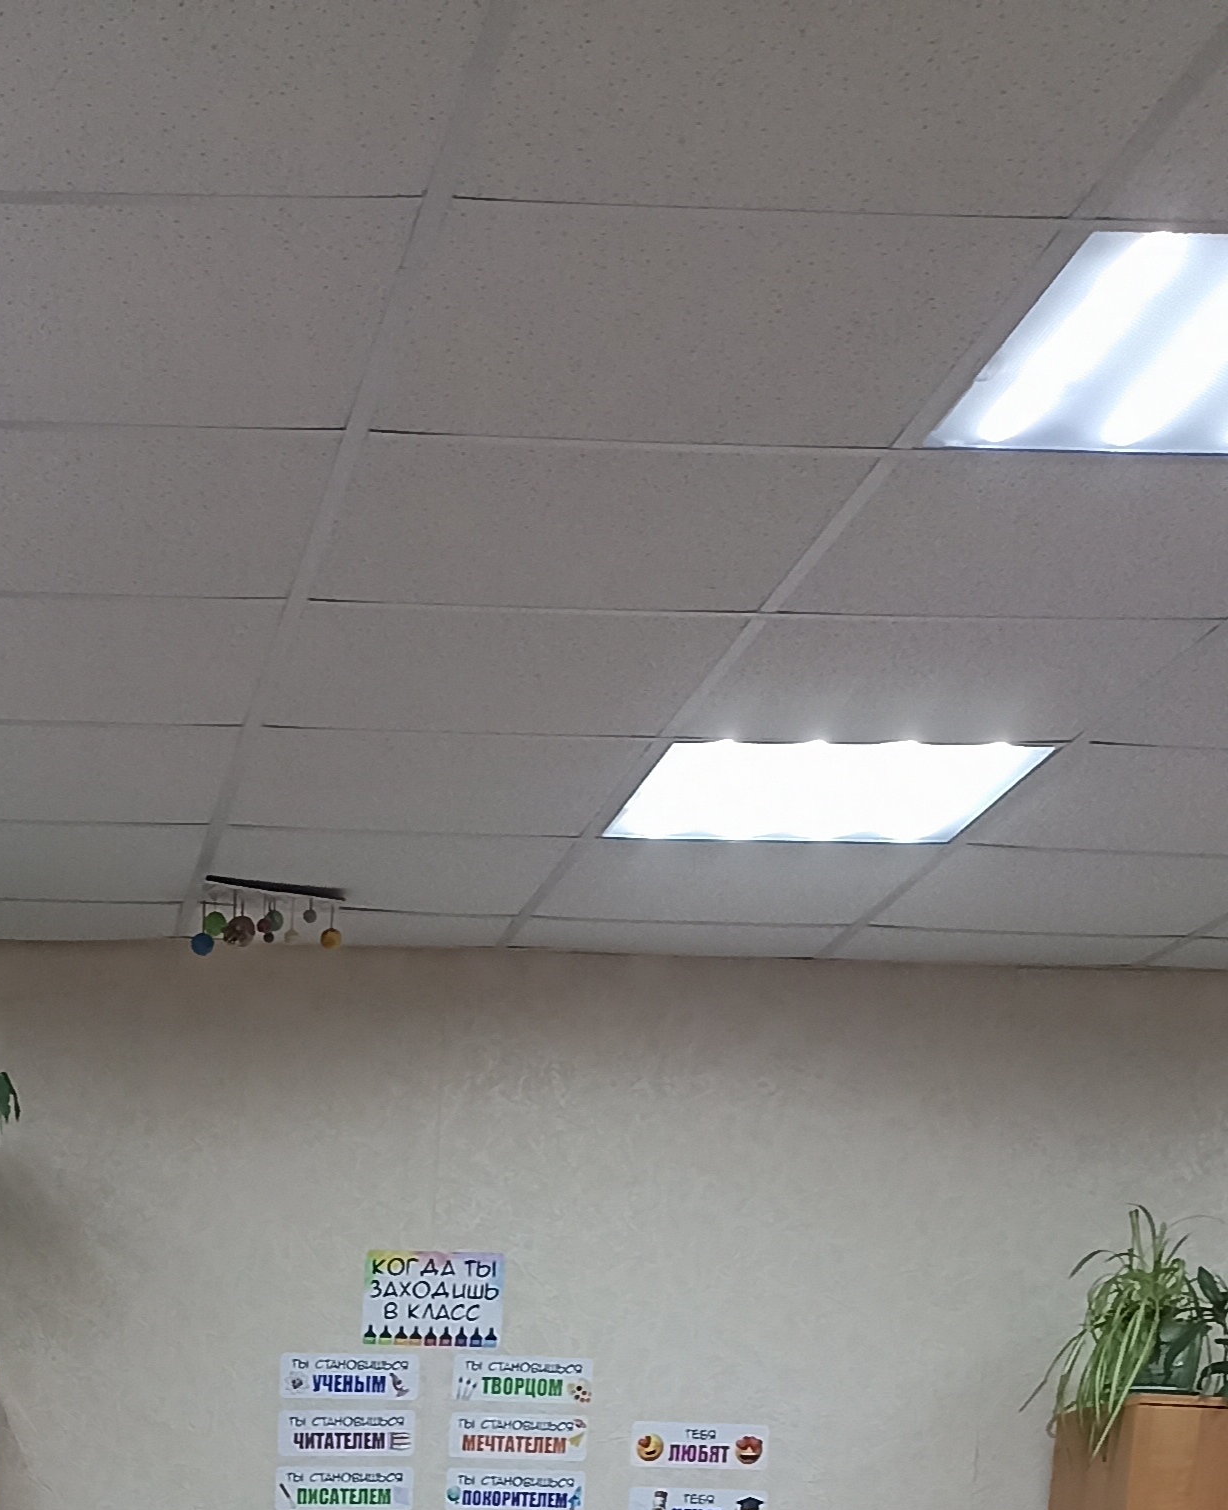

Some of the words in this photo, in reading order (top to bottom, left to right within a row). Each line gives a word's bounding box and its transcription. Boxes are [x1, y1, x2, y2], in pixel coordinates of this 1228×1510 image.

[372, 1257, 456, 1277] КОГДА
[464, 1259, 497, 1278] ТЫ
[370, 1279, 500, 1301] ЗАХОДИШЬ
[384, 1302, 398, 1320] В
[407, 1303, 481, 1321] КЛАСС
[292, 1358, 309, 1370] ТЫ
[314, 1358, 409, 1371] СТАНОВИШЬСЯ
[465, 1360, 483, 1371] ТЫ
[488, 1361, 583, 1374] СТАНОВИШЬСЯ
[312, 1374, 386, 1393] УЧЕНЫМ
[481, 1376, 563, 1398] ТВОРЦОМ
[289, 1416, 306, 1427] ТЫ
[311, 1416, 405, 1427] СТАНОВИШЬСЯ
[458, 1419, 475, 1429] ТЫ
[480, 1419, 573, 1431] СТАНОВИШЬСЯ
[293, 1432, 385, 1450] ЧИТАТЕЛЕМ
[685, 1429, 716, 1440] ТЕБЯ
[461, 1434, 566, 1454] МЕЧТАТЕЛЕМ
[668, 1444, 730, 1463] ЛЮБЯТ
[287, 1472, 304, 1483] ТЫ
[309, 1472, 404, 1483] СТАНОВИШЬСЯ
[458, 1474, 475, 1486] ТЫ
[480, 1475, 574, 1488] СТАНОВИШЬСЯ
[296, 1487, 392, 1505] ПИСАТЕЛЕМ
[462, 1490, 568, 1509] ПОКОРИТЕЛЕМ
[683, 1493, 715, 1505] ТЕБЯ
